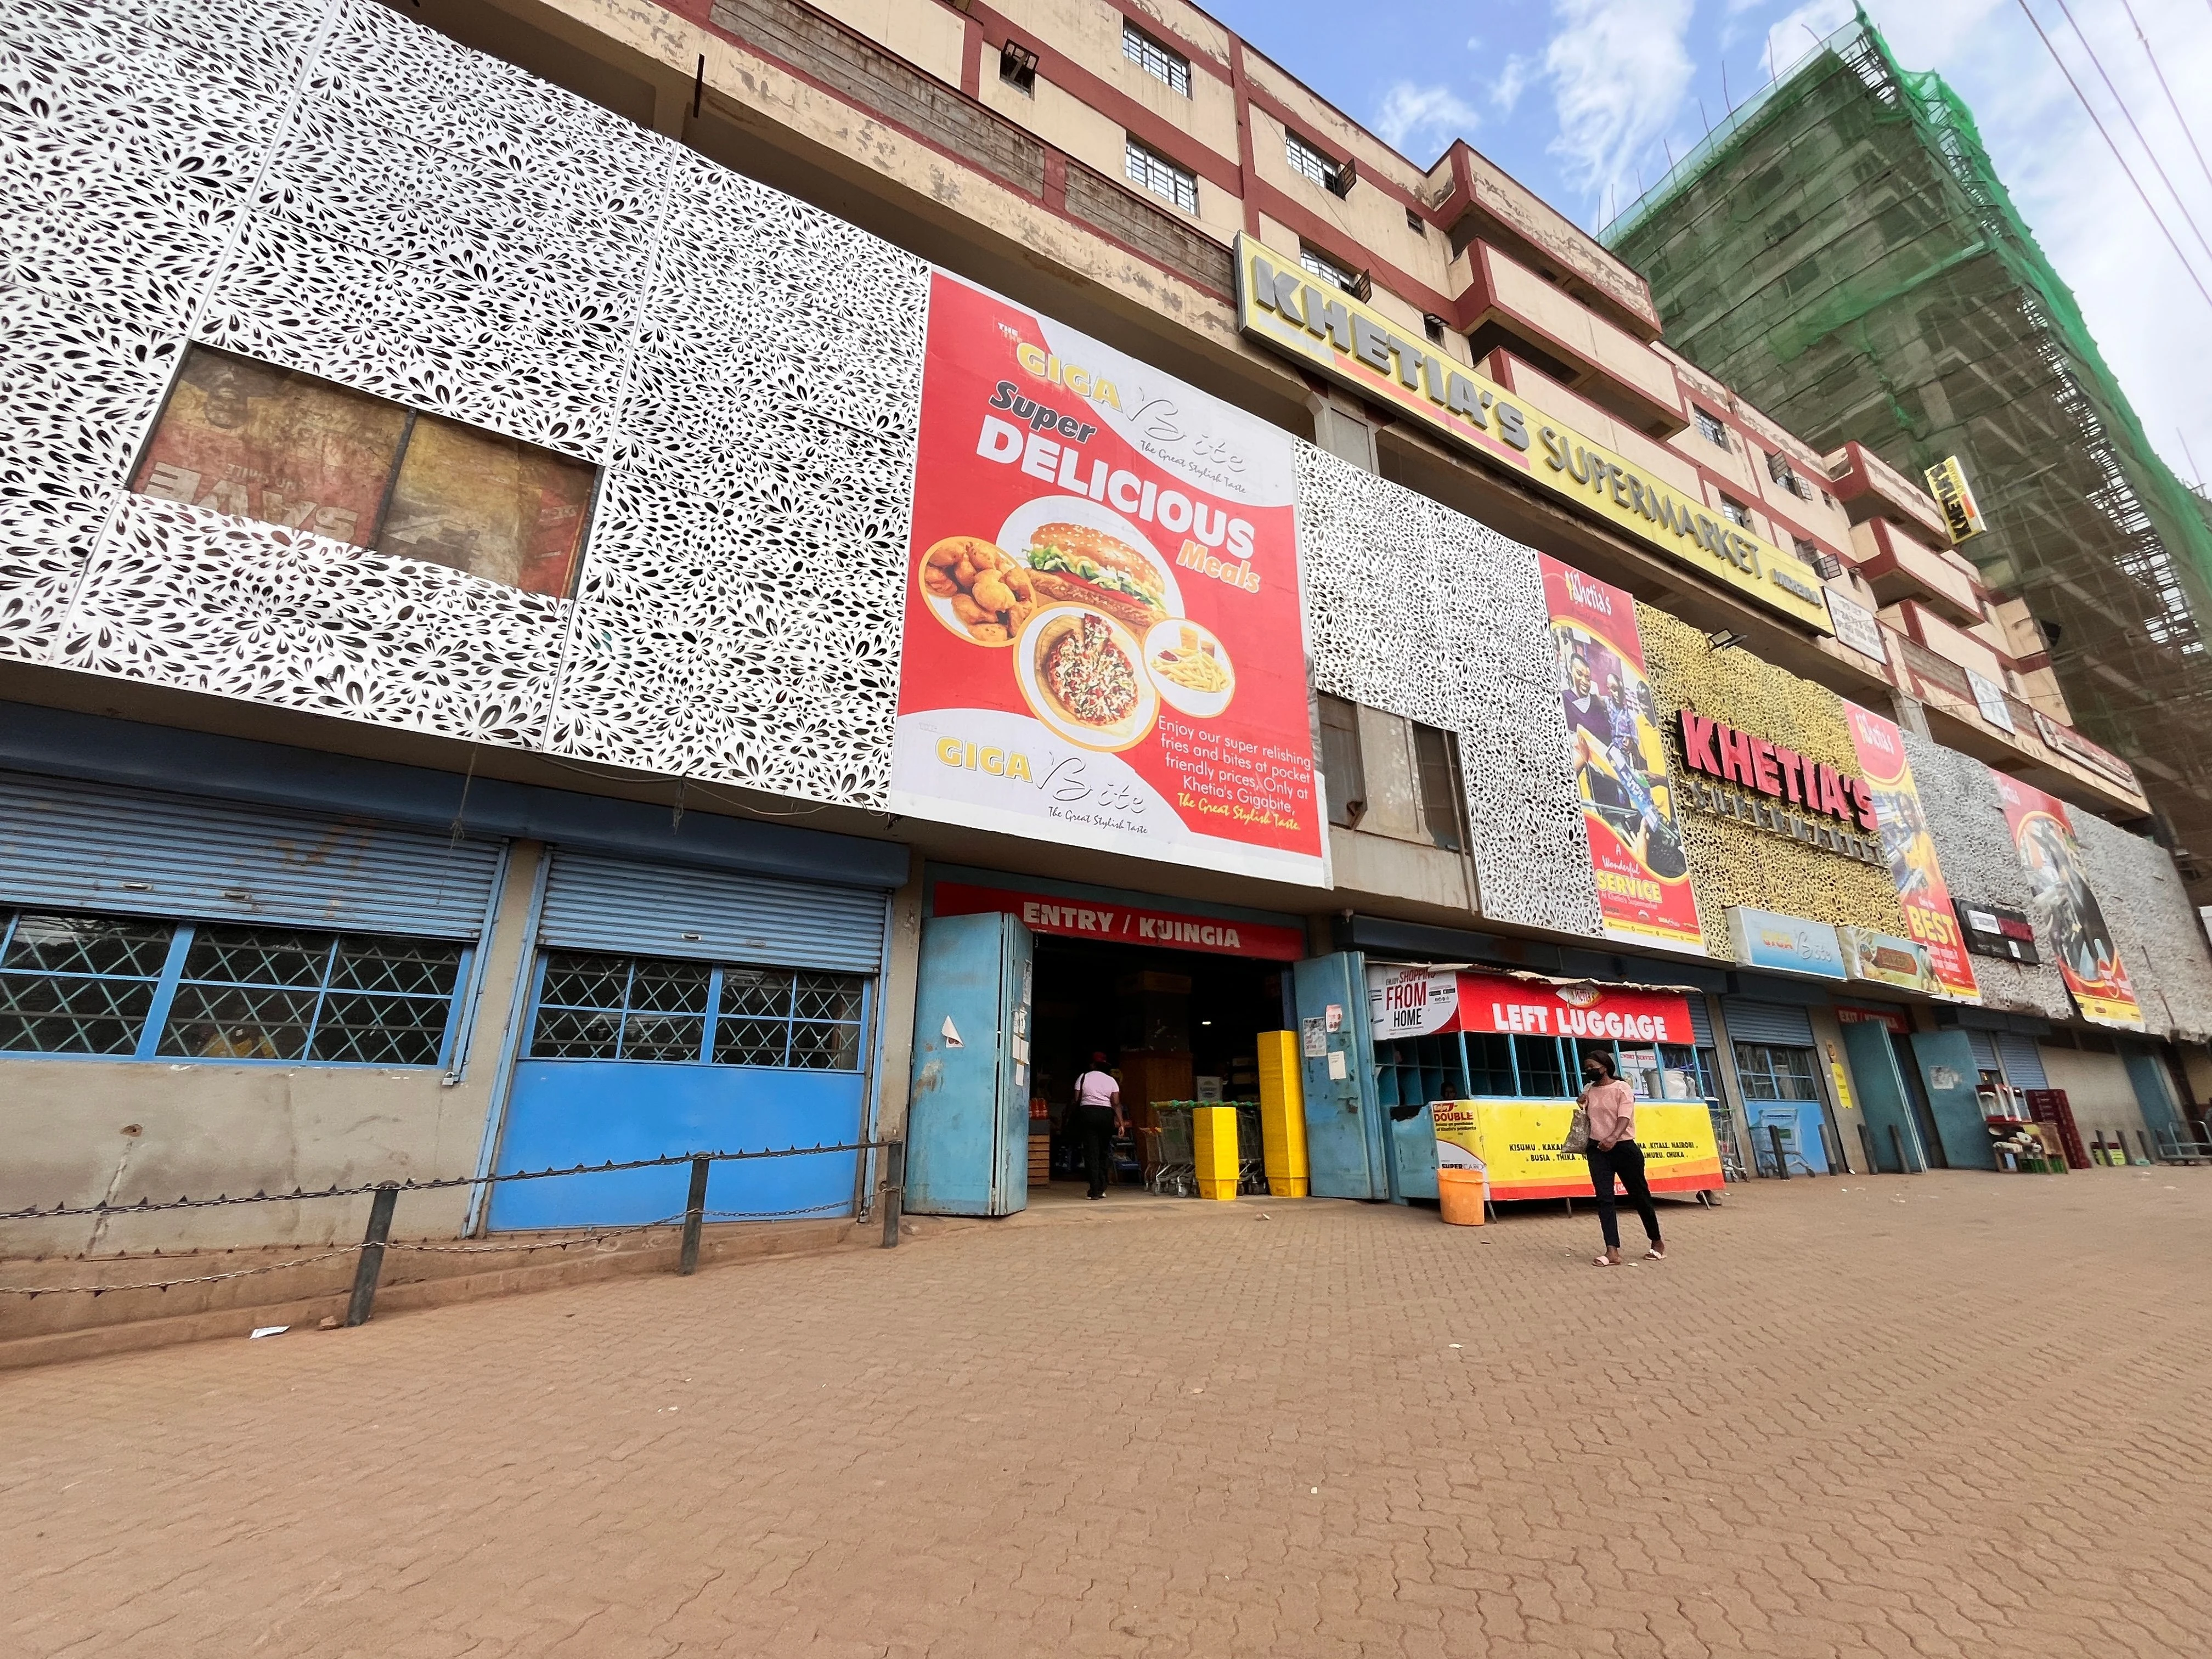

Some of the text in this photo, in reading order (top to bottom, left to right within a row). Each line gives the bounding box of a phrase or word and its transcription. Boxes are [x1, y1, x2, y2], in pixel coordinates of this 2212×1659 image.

[997, 321, 1018, 337] THE
[988, 380, 1096, 445] Super
[1017, 342, 1246, 472] GIGA Bite
[1252, 255, 1531, 453] KHETIA'S
[1537, 426, 1763, 580] SUPERMARKET
[976, 414, 1255, 559] DELICIOUS
[1140, 439, 1246, 494] The Great Stylish Taste
[1175, 540, 1261, 594] Meals
[1565, 571, 1611, 616] Khetia's
[1158, 715, 1312, 771] Enjoy our super relishing
[1160, 733, 1311, 784] fries and bites at pocket
[935, 736, 1147, 814] GIGA Bite
[1165, 752, 1215, 781] friendly
[1263, 777, 1294, 800] Only
[1297, 787, 1308, 800] at
[1679, 709, 1878, 831] KHETIA'S
[1177, 792, 1196, 808] The
[1198, 798, 1230, 816] Great
[1233, 805, 1271, 825] Stylish
[1183, 775, 1295, 816] Khetia's Gigabite,
[1048, 806, 1148, 834] The Great Stylish Taste
[1615, 843, 1622, 856] A
[1596, 868, 1663, 904] SERVICE
[1024, 901, 1114, 933] ENTRY
[1139, 917, 1241, 948] KUINGIA
[1906, 905, 1957, 946] BEST
[1386, 981, 1426, 1011] FROM
[1393, 1008, 1422, 1028] HOME
[1492, 1003, 1668, 1041] LEFT LUGGAGE
[1434, 1112, 1474, 1122] DOUBLE
